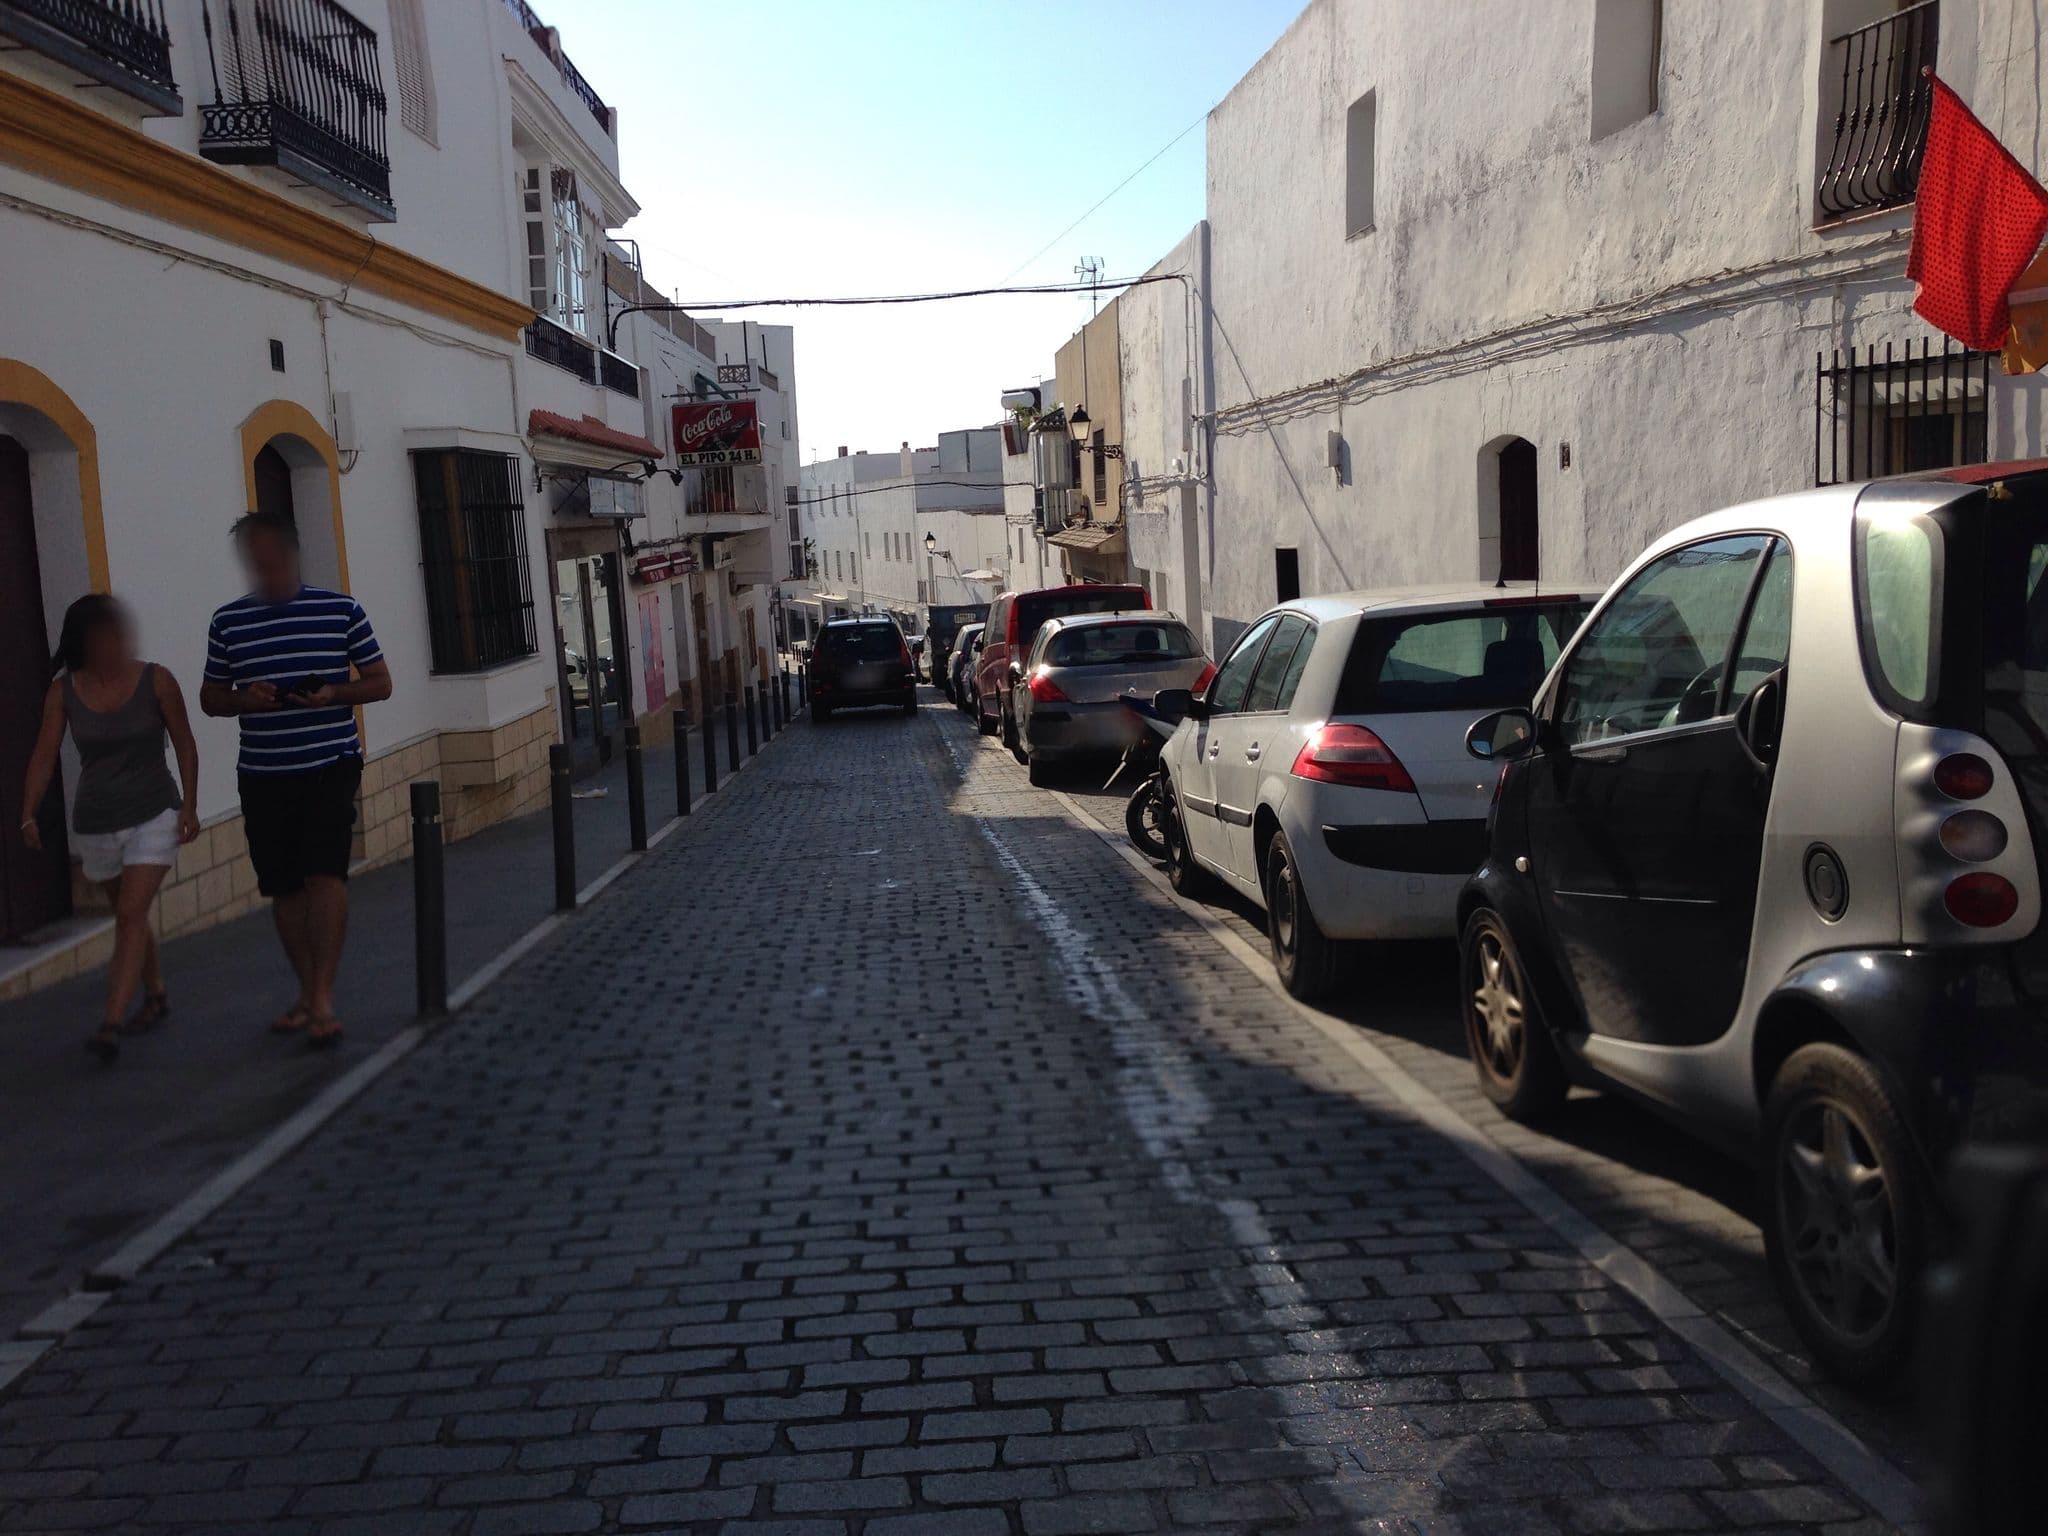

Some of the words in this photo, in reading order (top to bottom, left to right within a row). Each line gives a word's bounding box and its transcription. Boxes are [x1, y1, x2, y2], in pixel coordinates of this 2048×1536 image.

[681, 454, 696, 465] EL
[698, 451, 726, 464] PIPO
[729, 450, 742, 462] 24
[744, 449, 757, 461] H.
